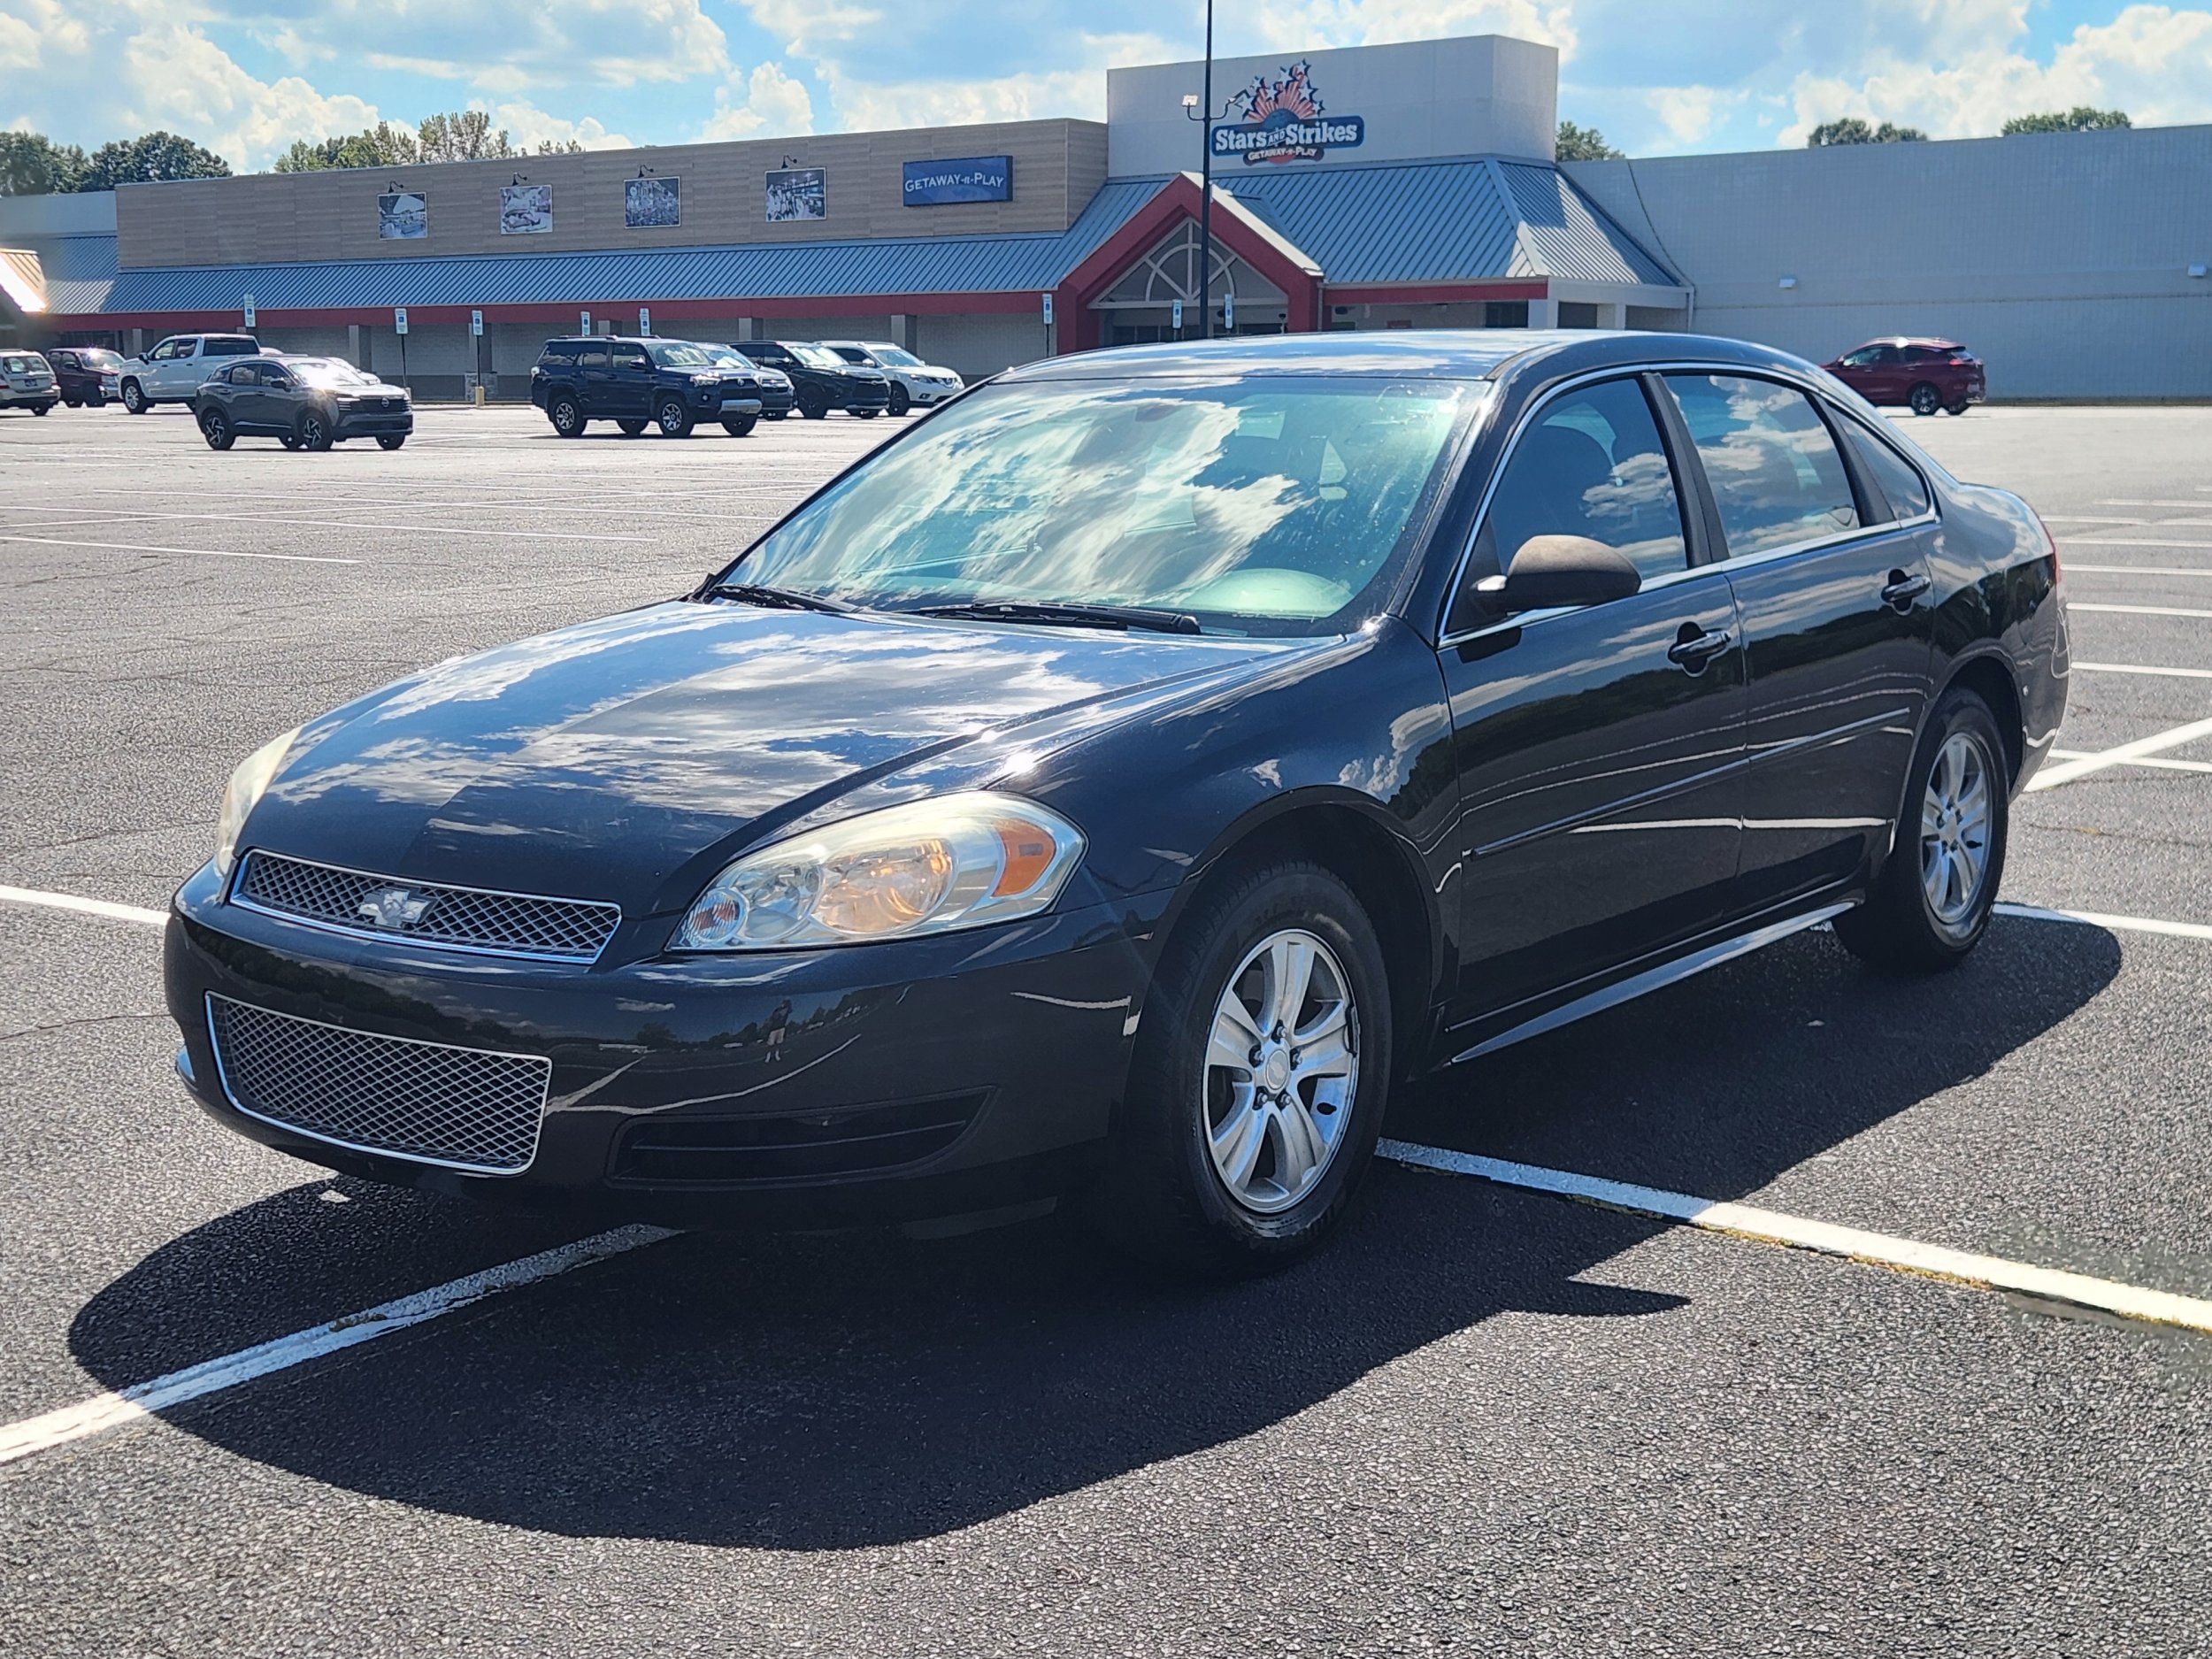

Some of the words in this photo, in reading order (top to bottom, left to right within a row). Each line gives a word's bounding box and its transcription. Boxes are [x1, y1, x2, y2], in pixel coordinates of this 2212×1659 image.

[1215, 128, 1267, 151] Stars
[1267, 130, 1286, 147] AND
[1285, 120, 1358, 146] Strikes
